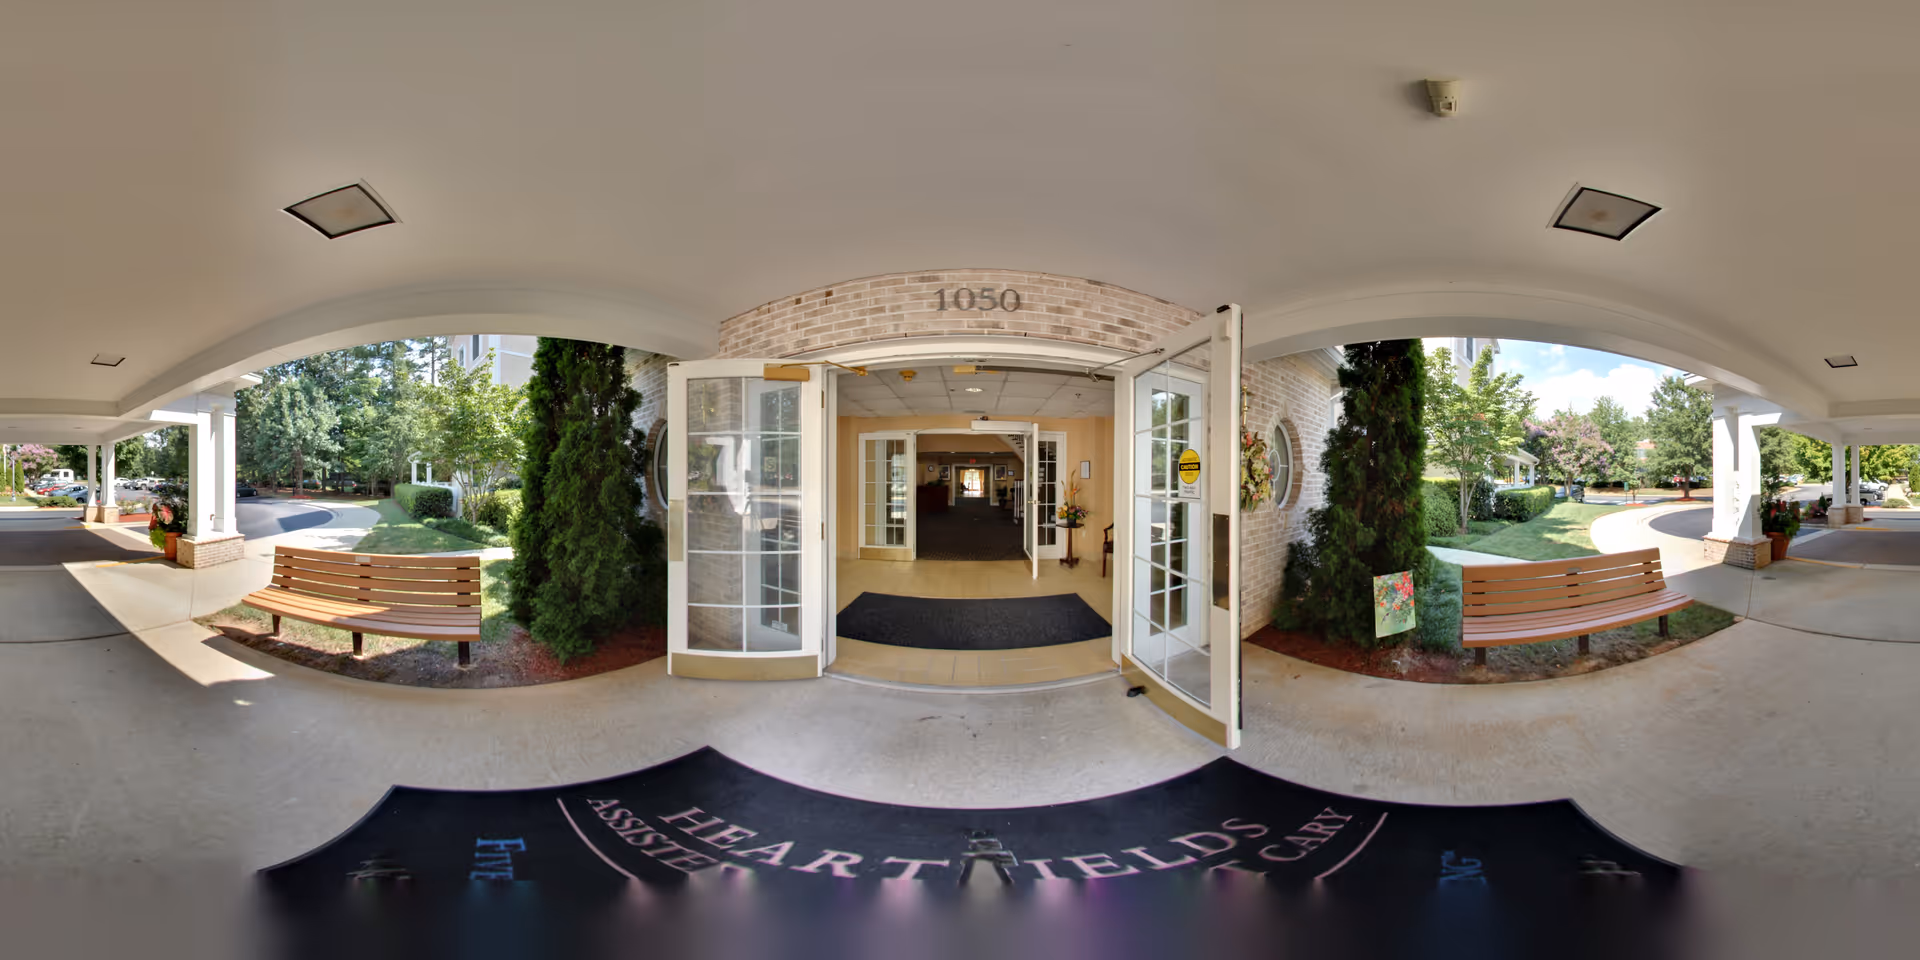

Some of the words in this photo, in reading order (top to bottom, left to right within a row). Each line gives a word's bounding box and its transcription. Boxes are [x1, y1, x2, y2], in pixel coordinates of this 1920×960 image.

[934, 286, 1021, 312] 1050
[470, 837, 526, 880] FIVE
[586, 798, 753, 876] ASSISTE
[1257, 806, 1353, 862] CARY
